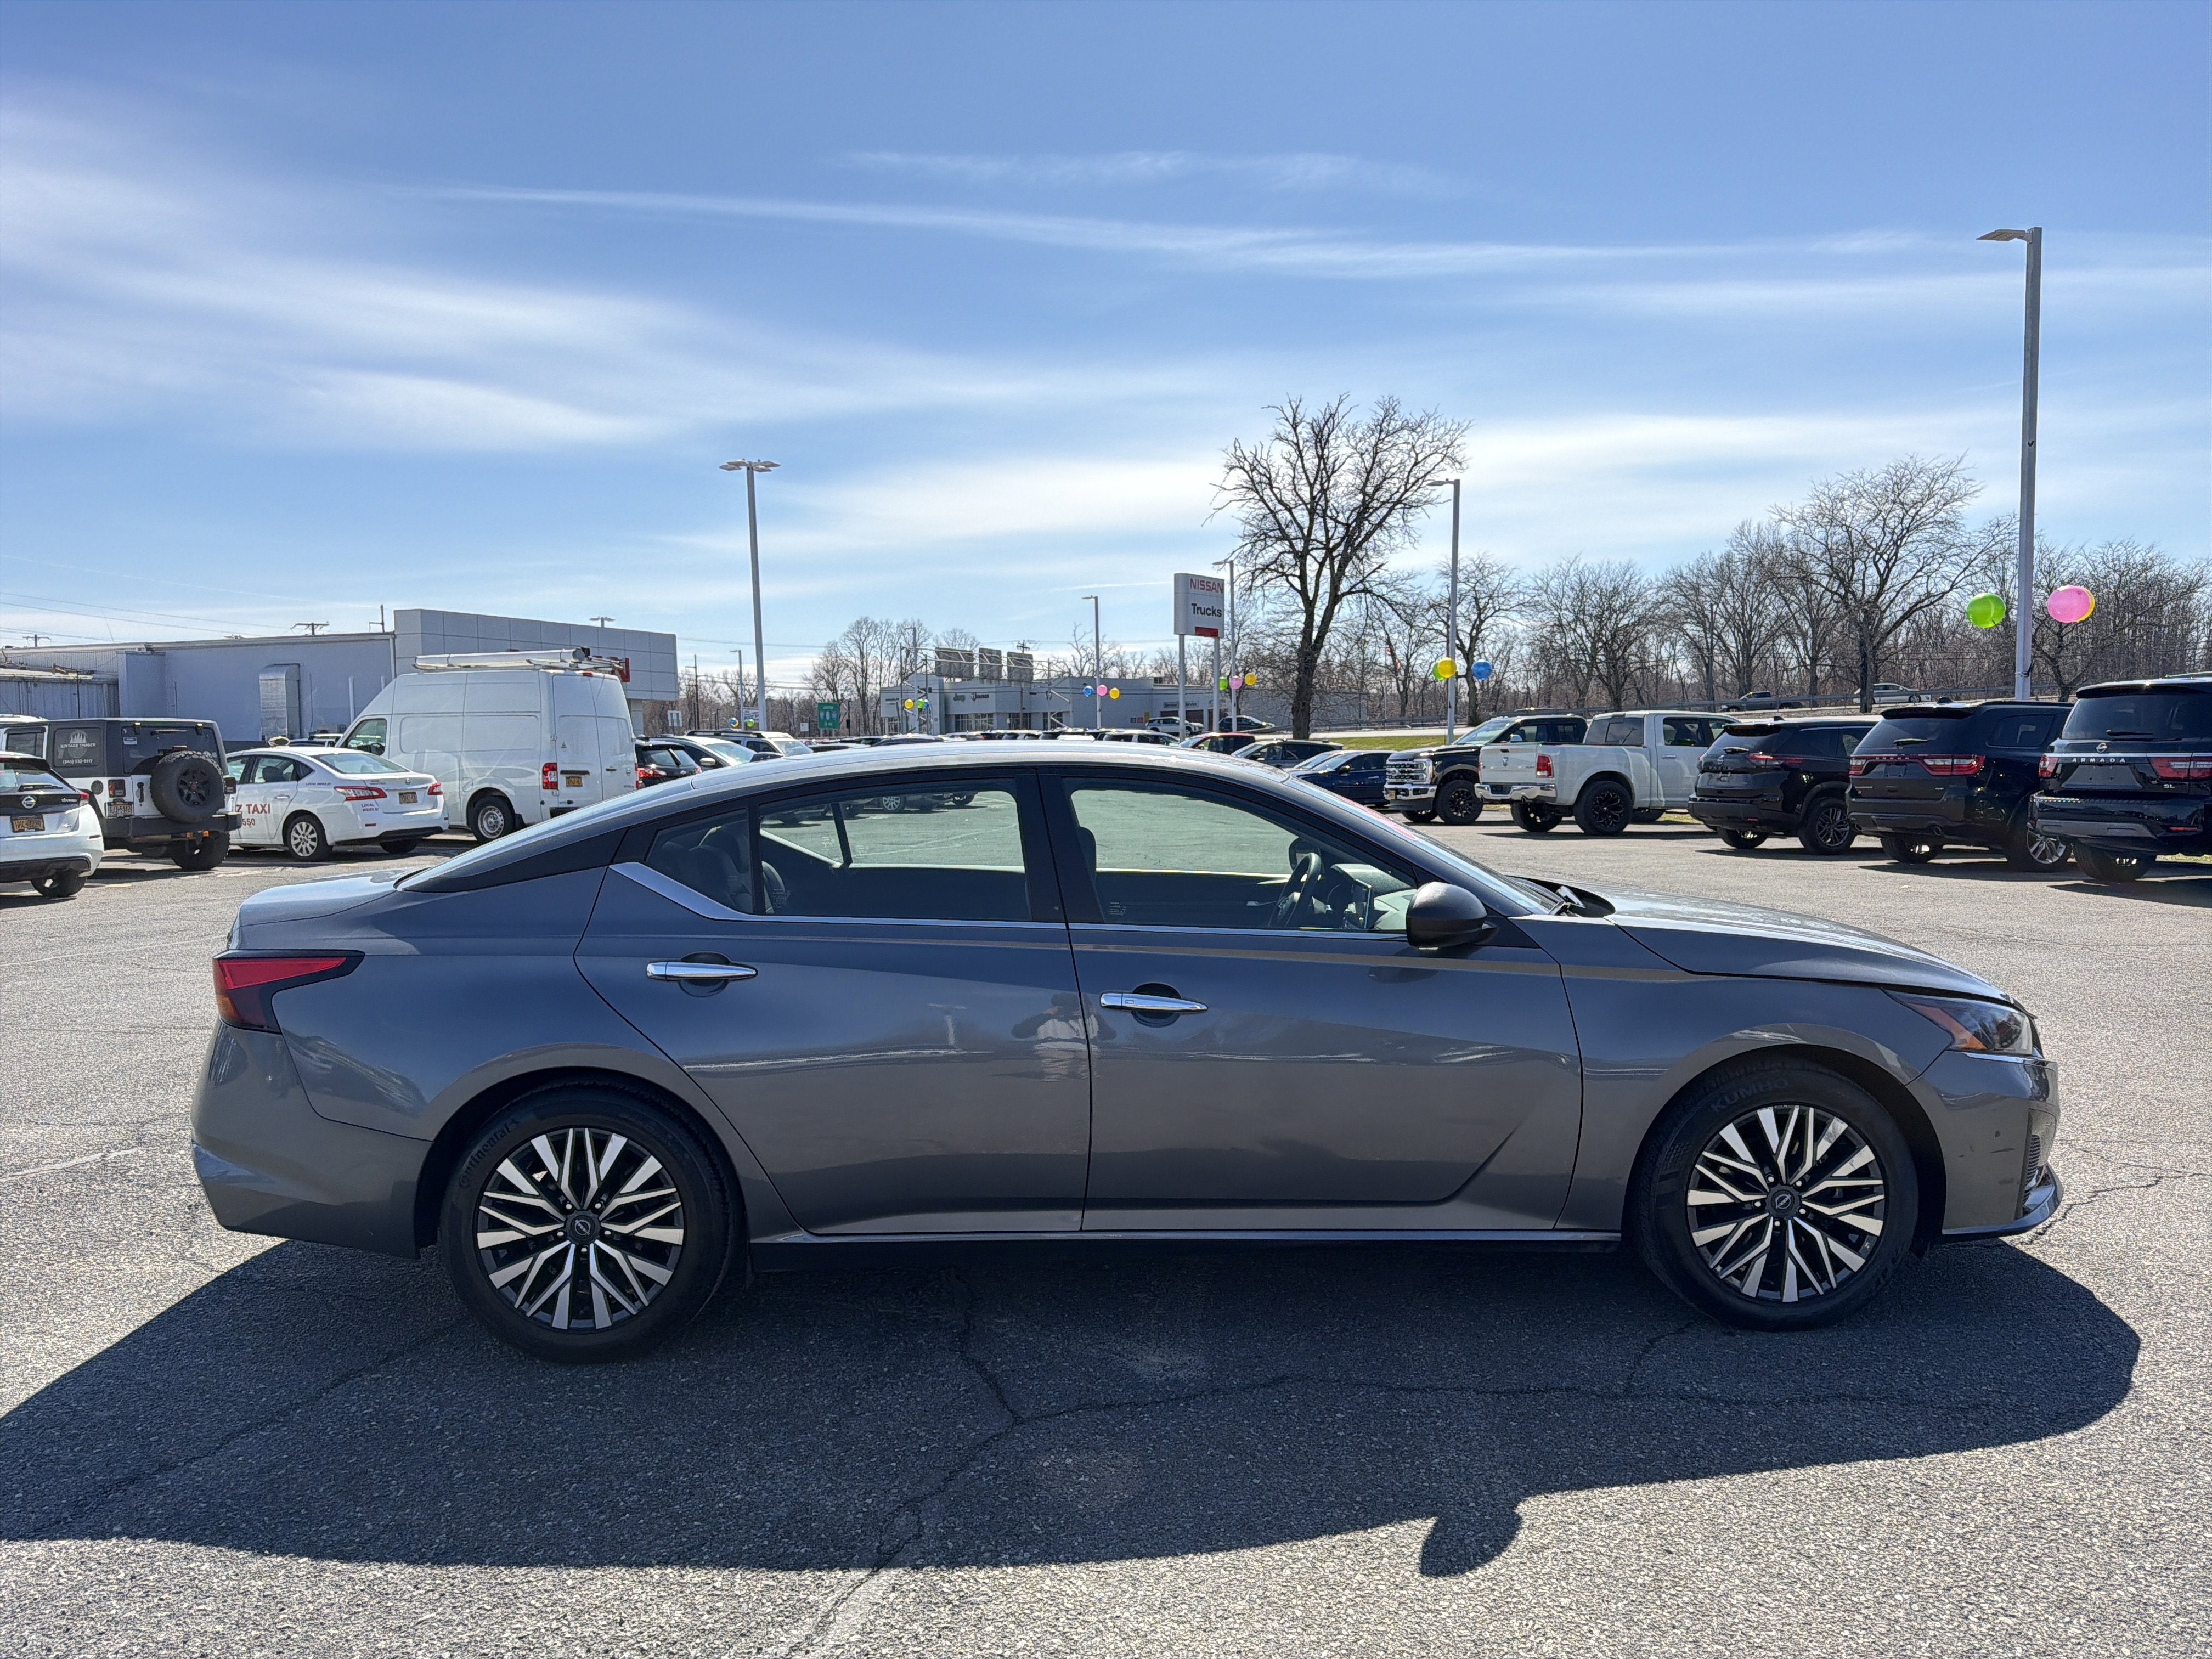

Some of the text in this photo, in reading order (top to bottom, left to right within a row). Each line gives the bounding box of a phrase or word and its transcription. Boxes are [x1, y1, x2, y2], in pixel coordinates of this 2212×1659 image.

[1190, 578, 1223, 594] NISSAN
[1191, 603, 1222, 617] Trucks
[245, 804, 270, 814] TAXI
[1711, 1079, 1789, 1113] KUMHO
